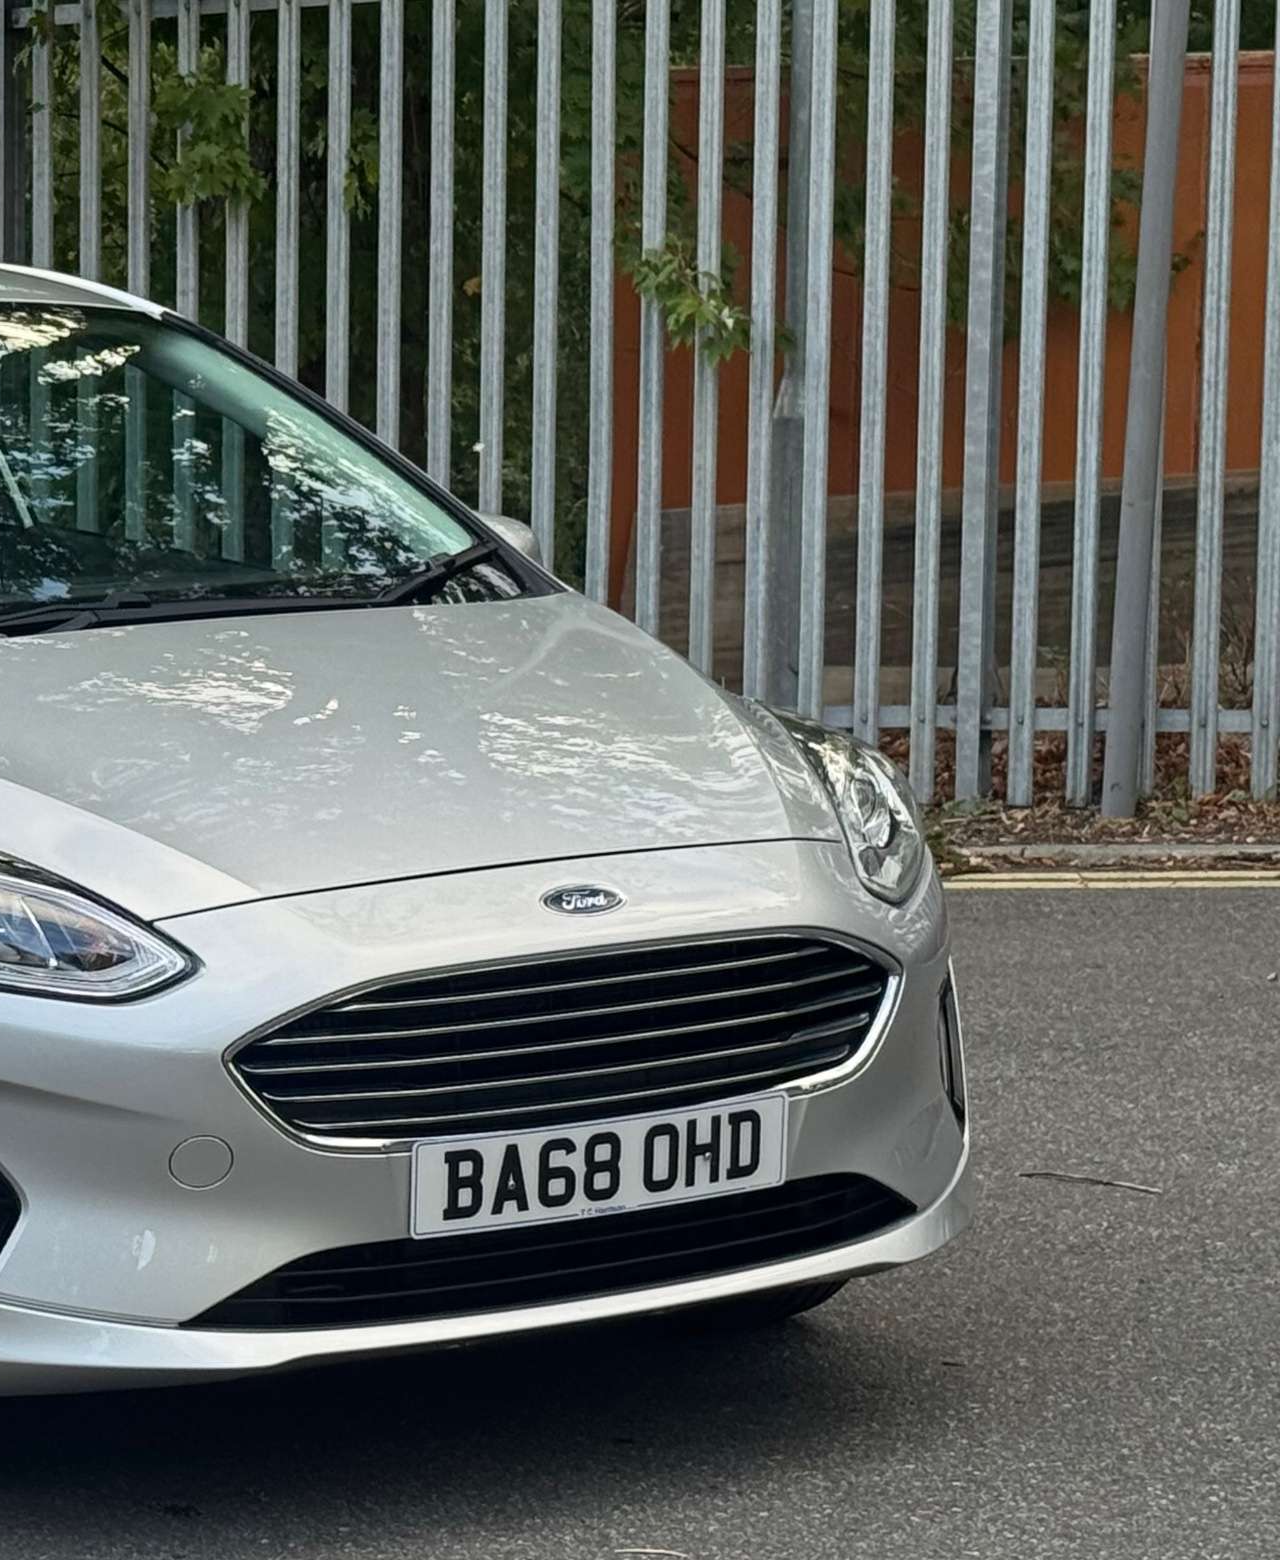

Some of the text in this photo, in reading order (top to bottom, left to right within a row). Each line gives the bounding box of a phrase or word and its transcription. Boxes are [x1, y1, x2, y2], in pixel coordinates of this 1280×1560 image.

[562, 890, 608, 911] Ford
[442, 1109, 762, 1221] BA68 OHD
